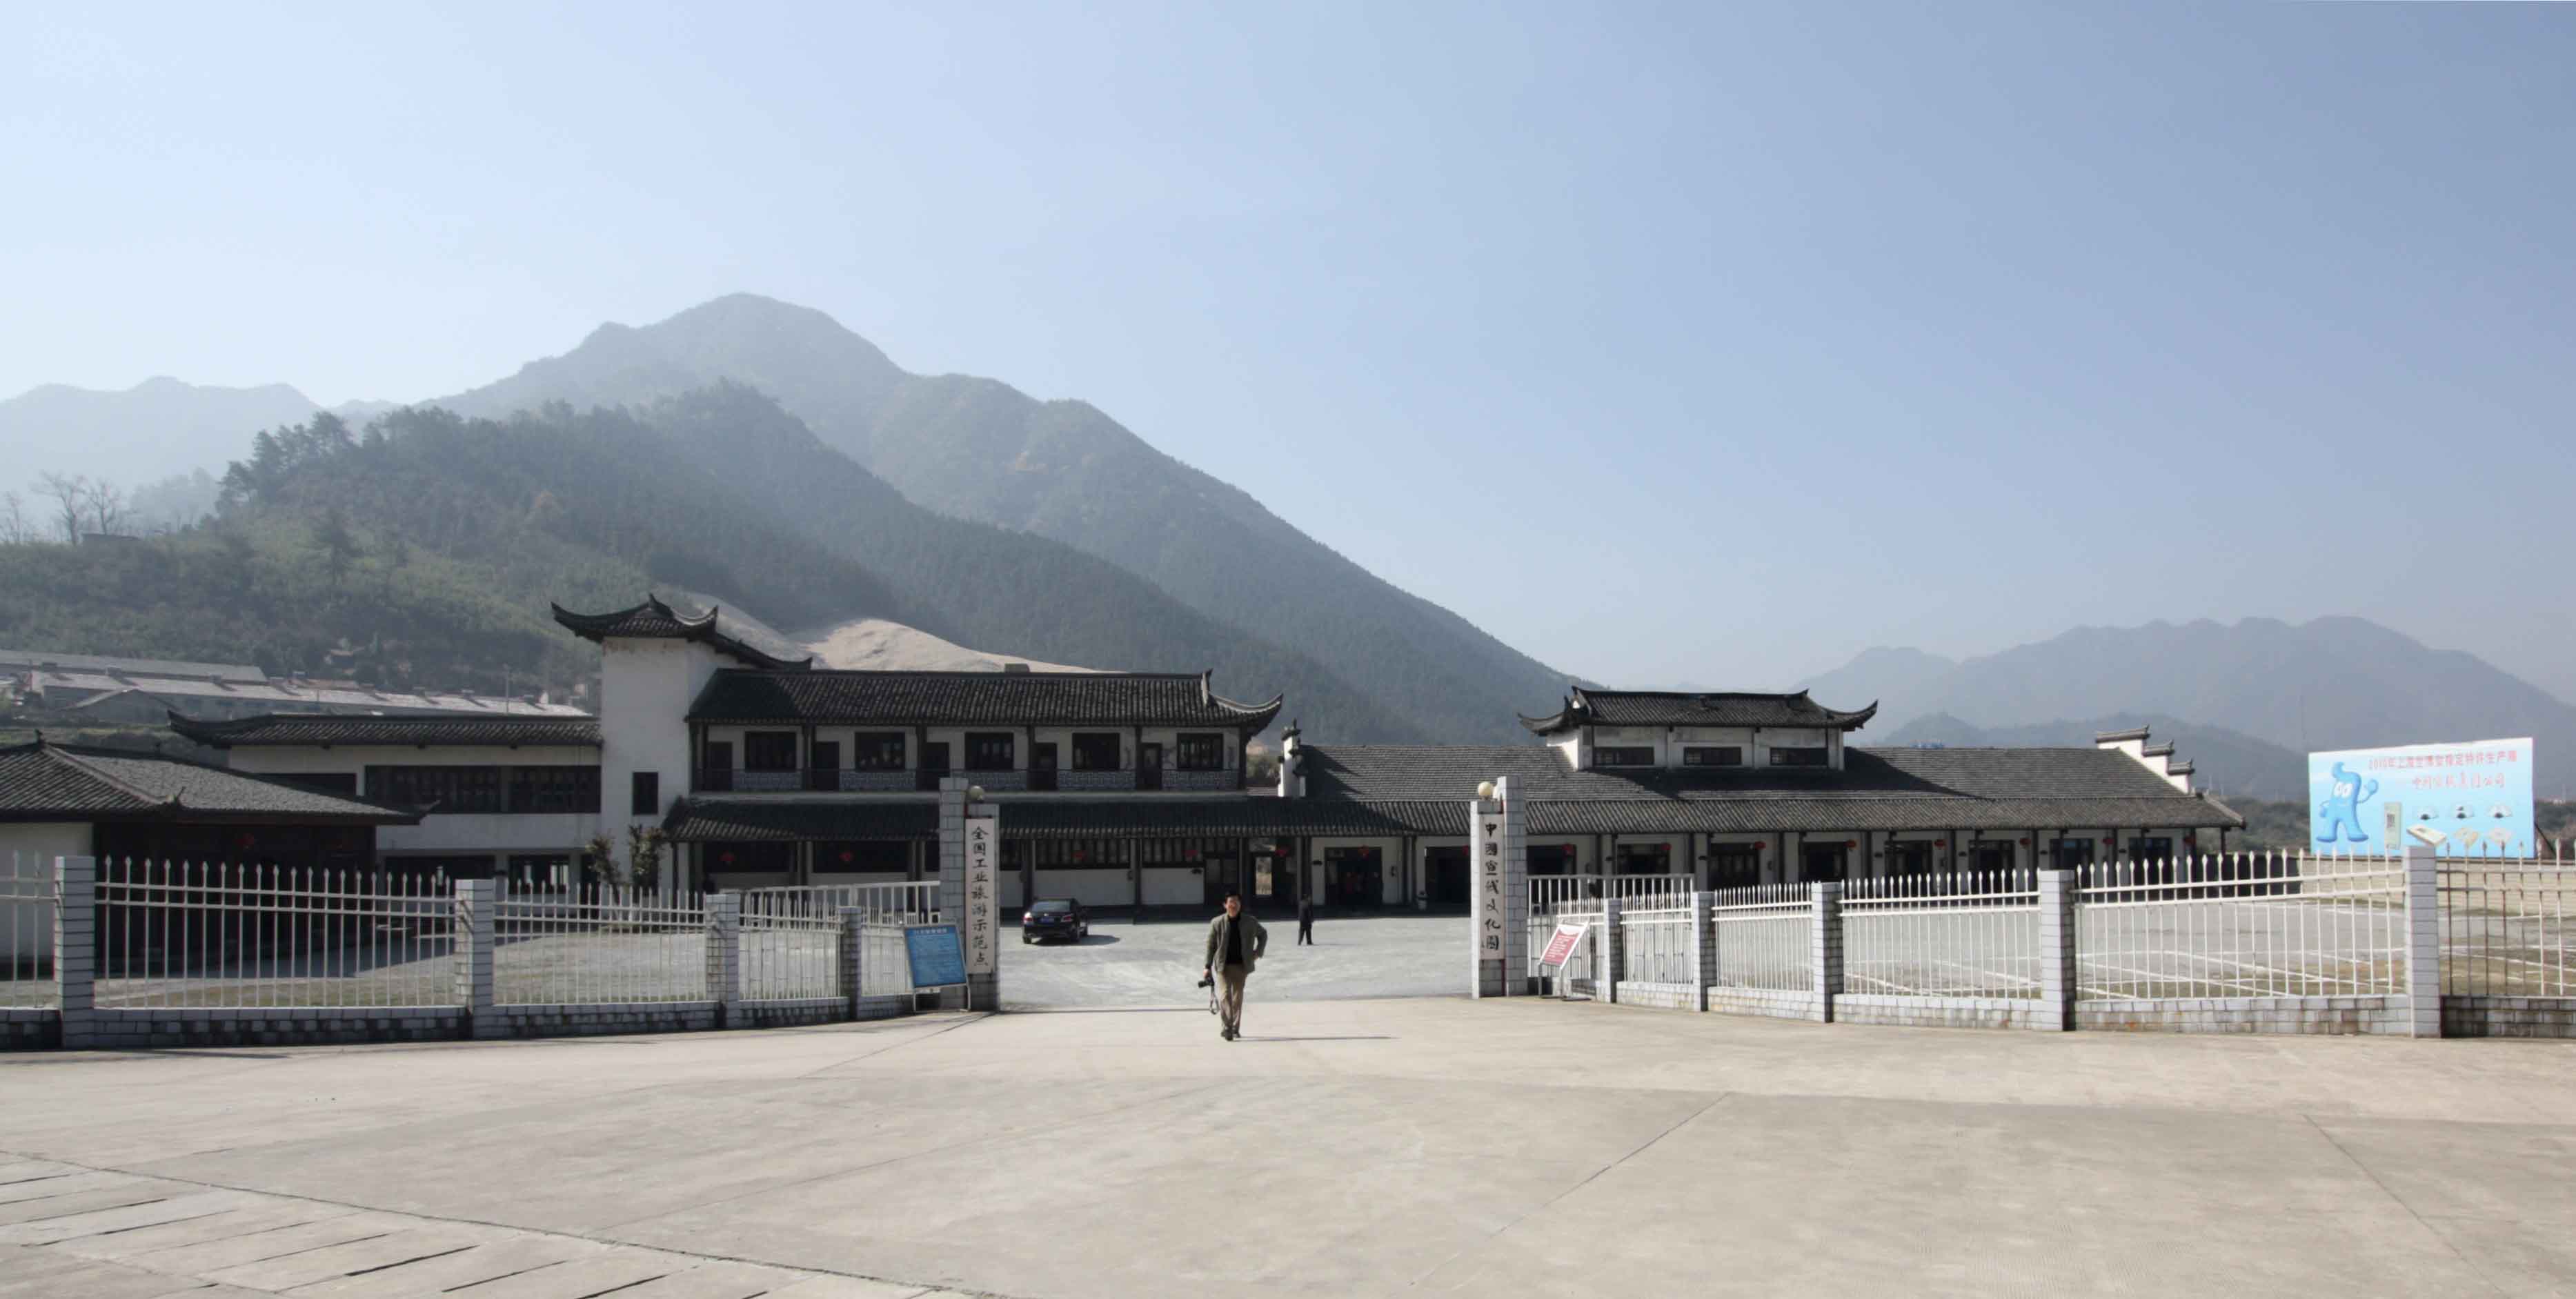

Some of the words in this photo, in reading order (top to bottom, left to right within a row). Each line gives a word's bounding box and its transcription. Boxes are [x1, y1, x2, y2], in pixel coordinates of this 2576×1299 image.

[971, 826, 989, 966] 全国工业旅游示范点
